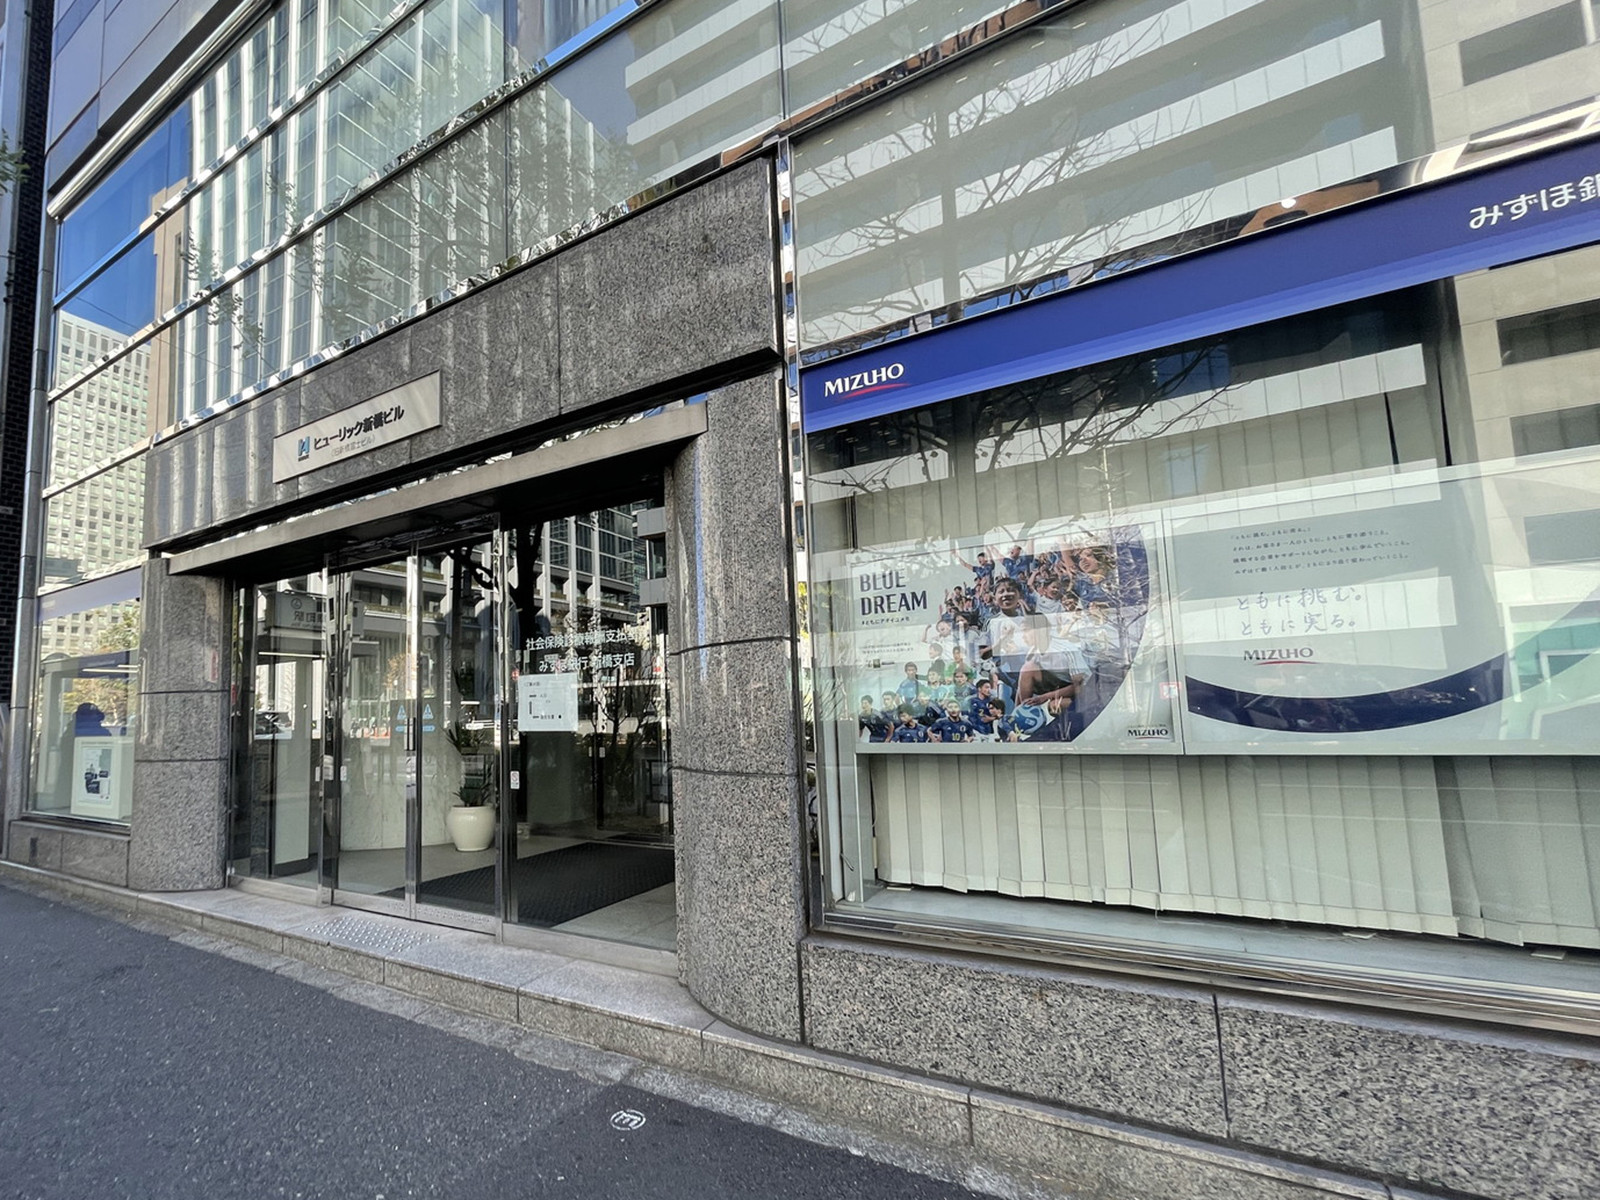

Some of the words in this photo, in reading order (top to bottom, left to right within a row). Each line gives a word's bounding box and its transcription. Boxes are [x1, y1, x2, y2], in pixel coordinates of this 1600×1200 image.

[824, 363, 904, 398] MIZUHO
[314, 405, 404, 451] ヒューリック新橋ビル
[860, 567, 906, 592] BLUE
[861, 590, 928, 616] DREAM
[1237, 587, 1362, 610] ともに挑む。
[1241, 612, 1356, 635] ともに実る。
[538, 656, 589, 673] みずほ銀行
[592, 652, 635, 668] 新橋支店
[1243, 647, 1314, 661] MIZUHO
[1127, 729, 1168, 737] MIZUHO
